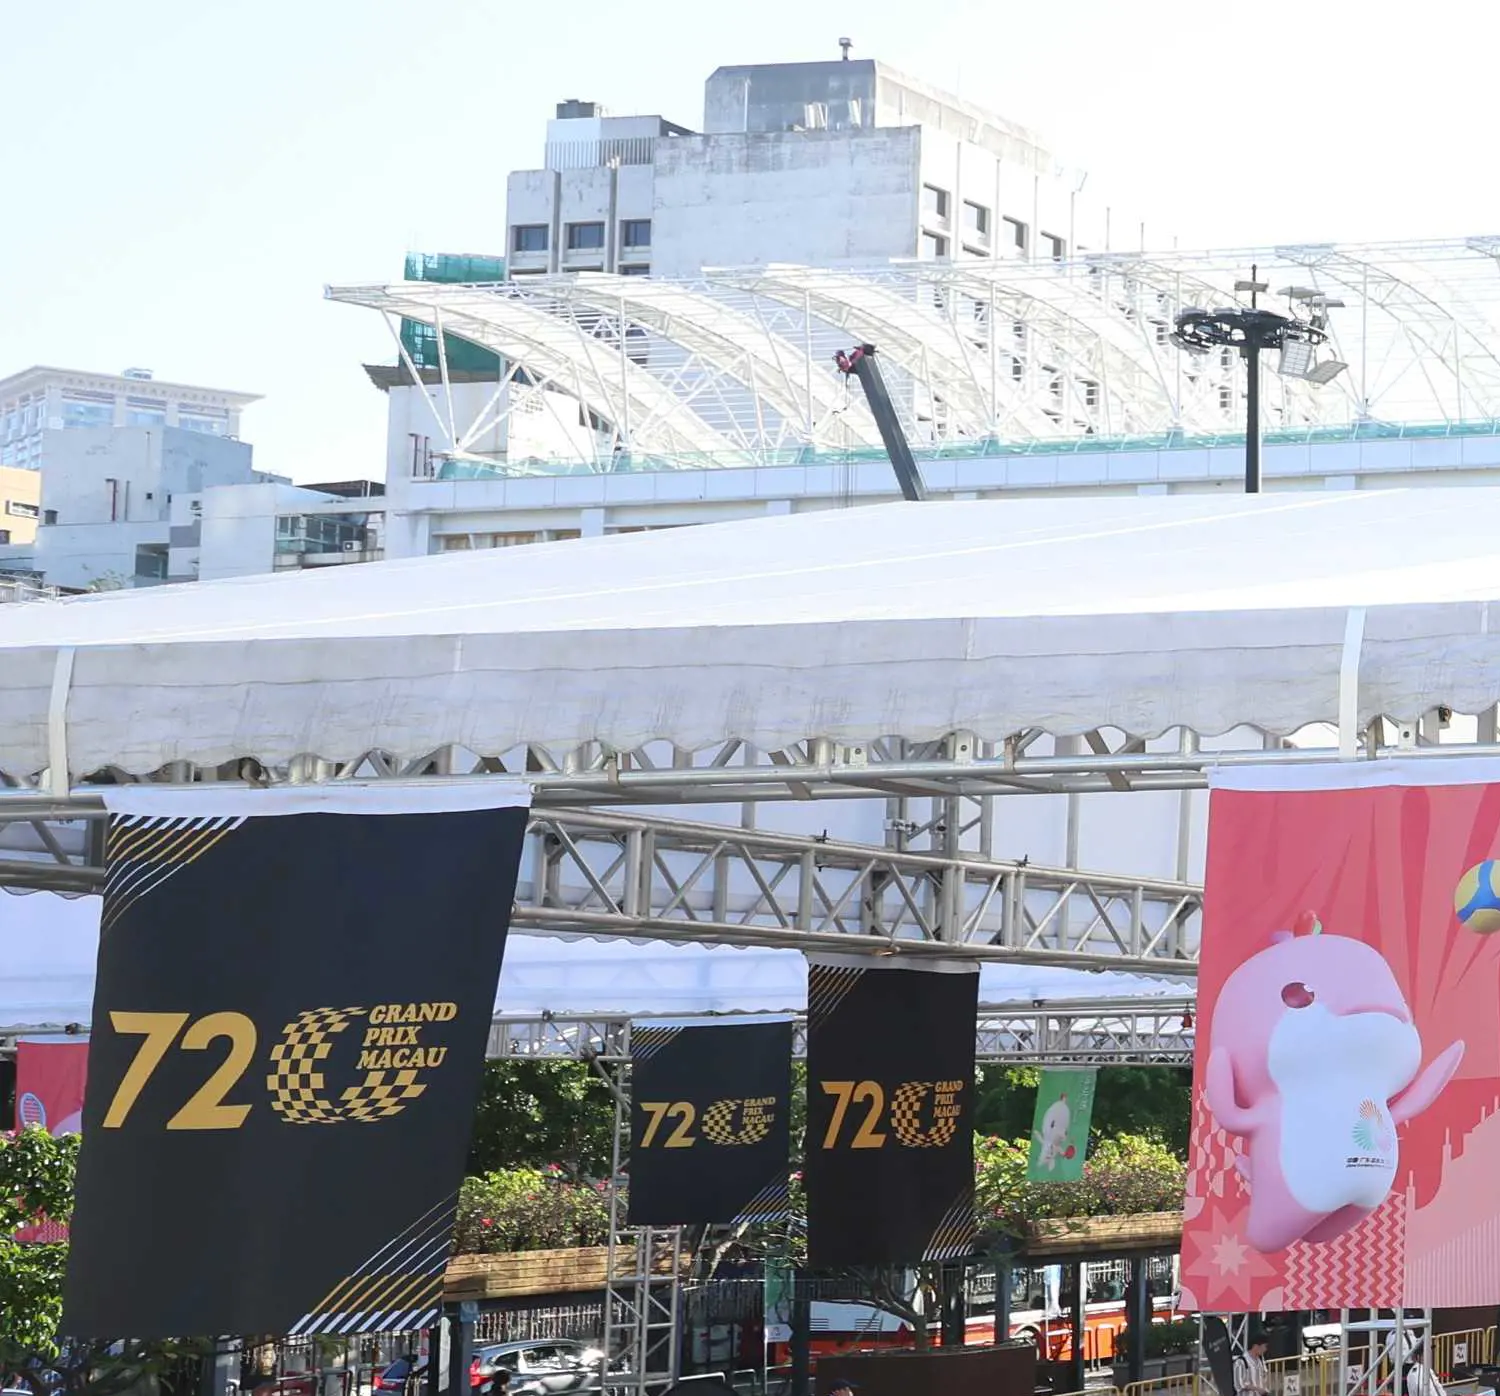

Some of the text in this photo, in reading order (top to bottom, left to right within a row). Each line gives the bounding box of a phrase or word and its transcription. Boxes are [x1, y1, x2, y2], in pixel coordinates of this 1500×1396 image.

[367, 1002, 457, 1024] GRAND
[363, 1026, 419, 1047] PRIX
[102, 1011, 257, 1129] 72
[356, 1047, 447, 1069] MACAU
[639, 1102, 696, 1148] 72
[821, 1081, 887, 1149] 72
